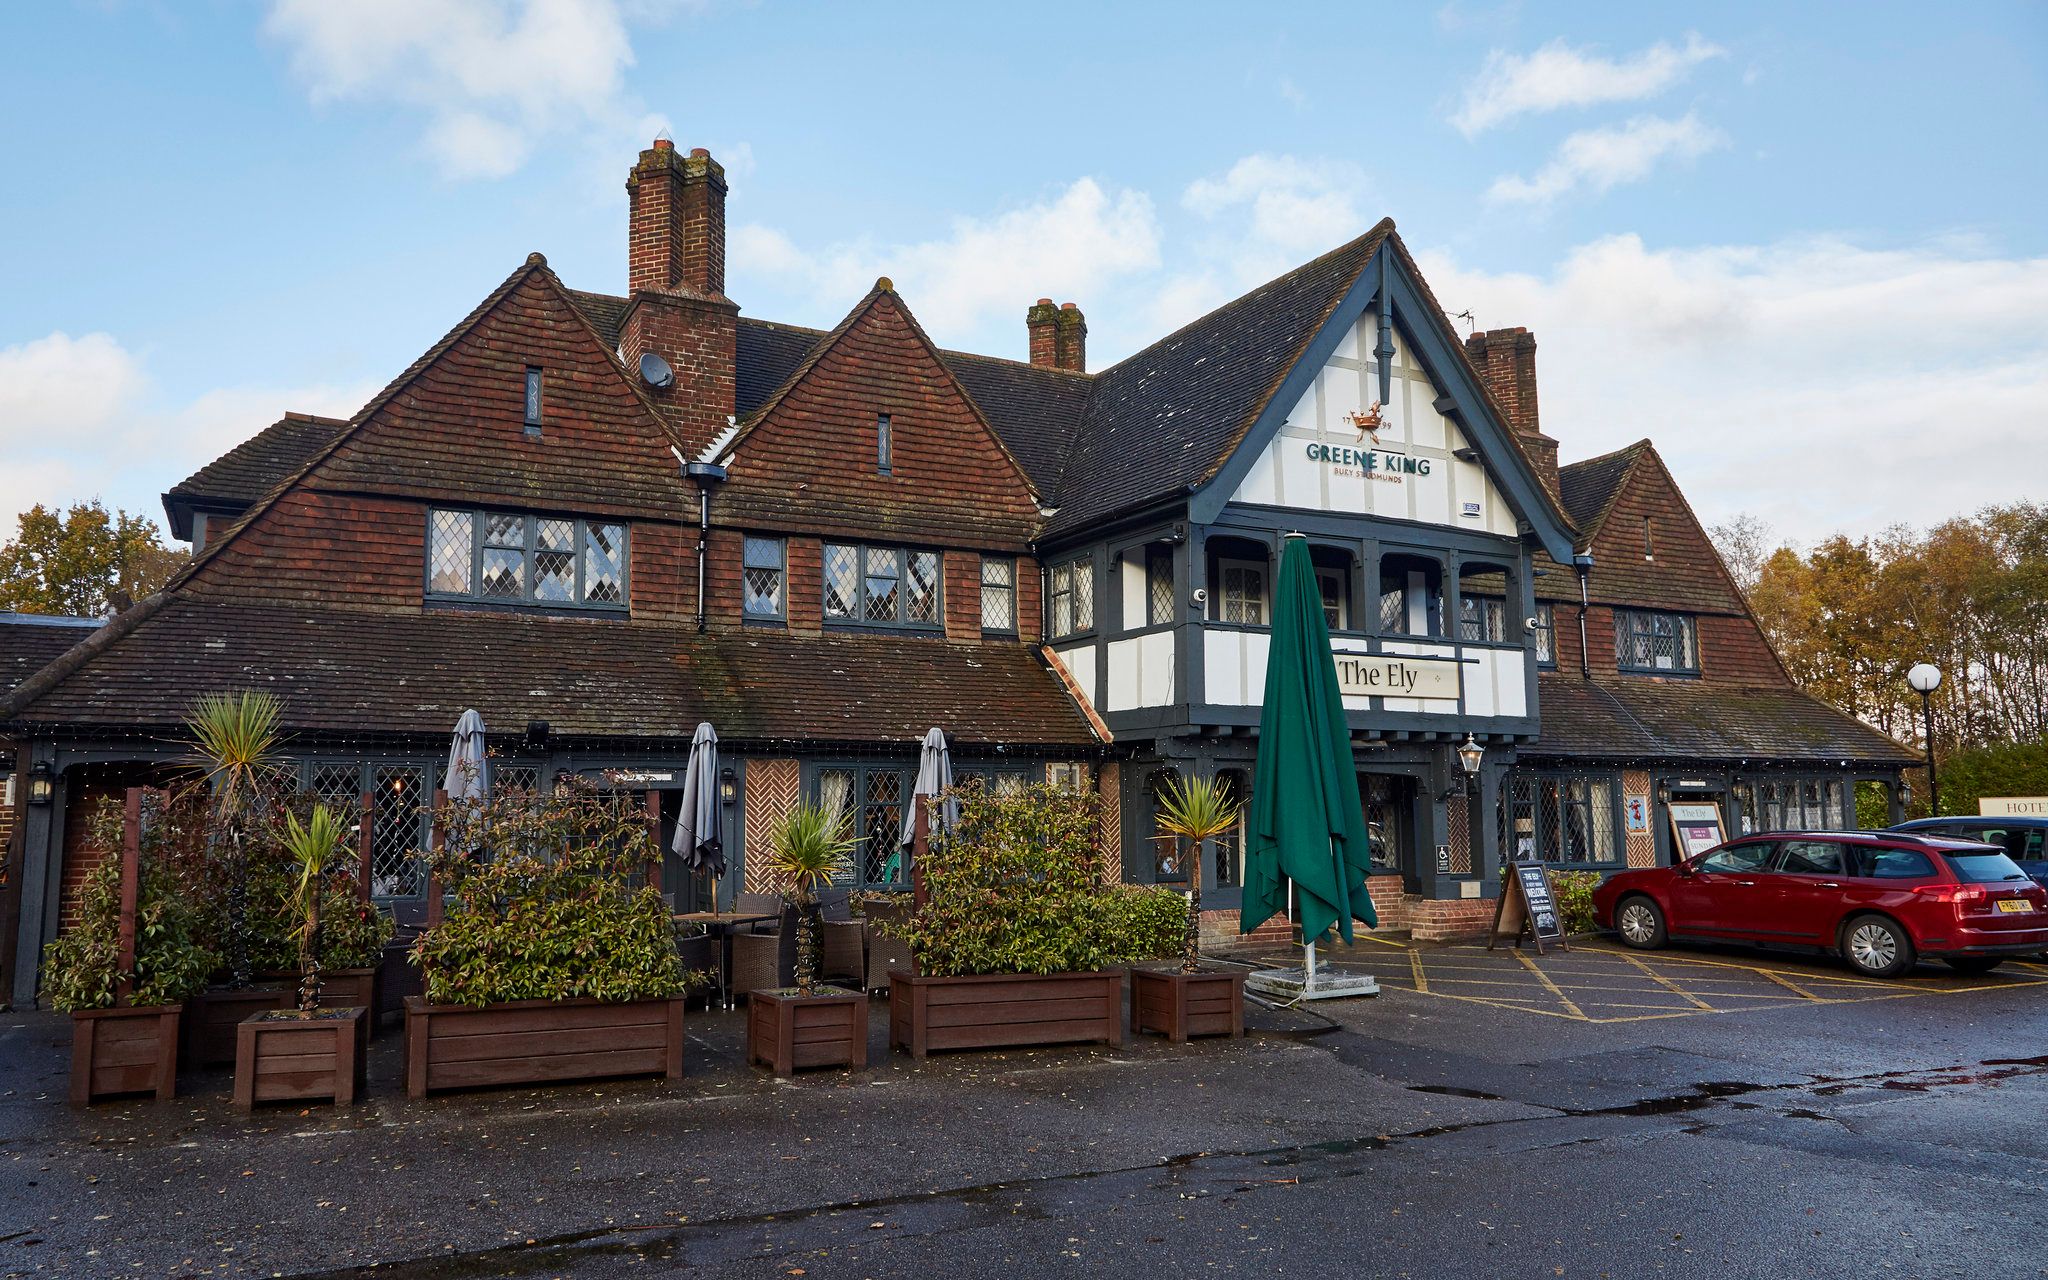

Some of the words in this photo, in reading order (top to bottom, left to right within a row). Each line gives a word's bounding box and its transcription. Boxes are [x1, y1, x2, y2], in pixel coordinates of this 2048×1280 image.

[1342, 417, 1351, 425] 17
[1382, 422, 1392, 430] 99
[1306, 443, 1378, 469] GREENE
[1385, 455, 1431, 475] KING
[1334, 467, 1354, 476] BURY
[1365, 472, 1402, 484] EDMUNDS
[1338, 660, 1380, 686] The
[1387, 663, 1418, 693] Ely
[2007, 802, 2048, 814] HOTE
